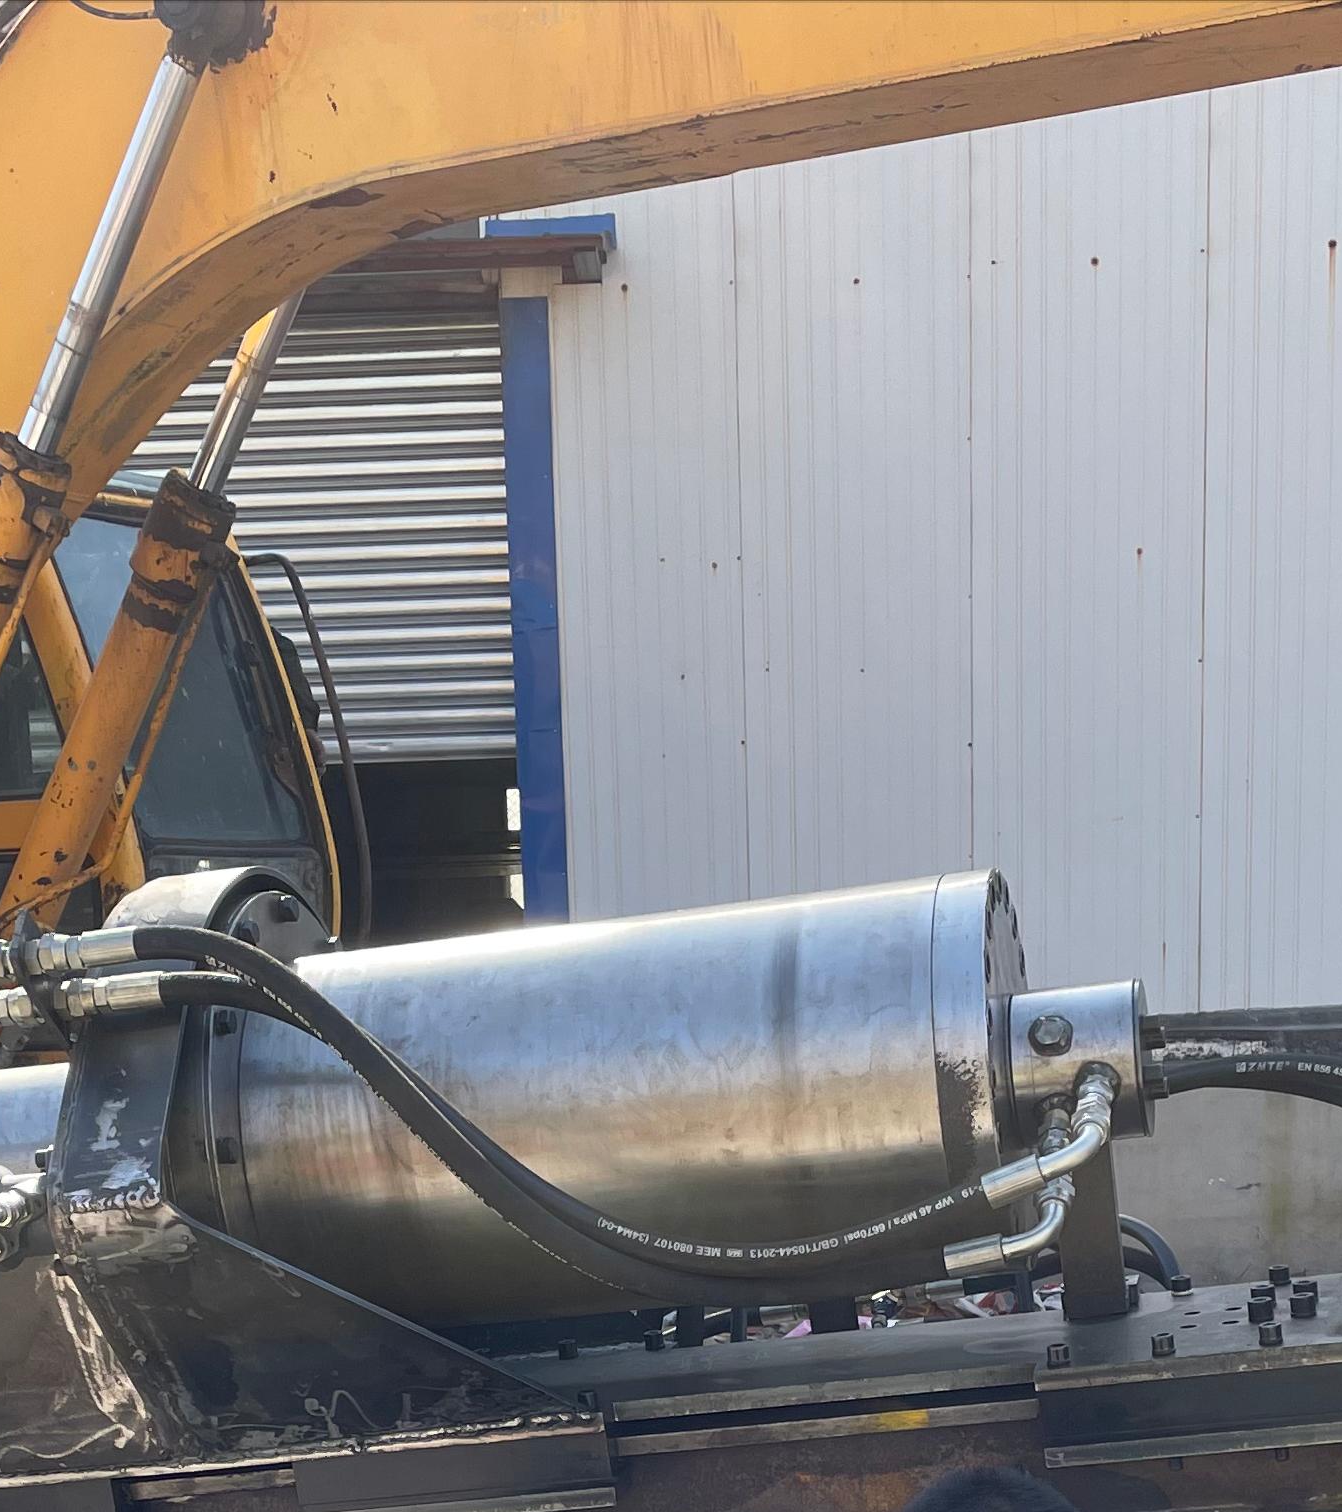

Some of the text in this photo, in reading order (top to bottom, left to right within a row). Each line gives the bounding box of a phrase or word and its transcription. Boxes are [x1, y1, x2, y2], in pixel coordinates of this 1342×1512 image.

[1297, 1062, 1312, 1071] EN
[1314, 1064, 1331, 1074] 856
[930, 1195, 954, 1212] WP
[893, 1208, 918, 1226] MPa
[597, 1216, 650, 1244] (34M4-04)
[844, 1222, 886, 1245] 6670psi
[654, 1238, 694, 1254] 080107
[696, 1245, 721, 1258] MEE
[749, 1237, 839, 1259] GB/T10544-2013
